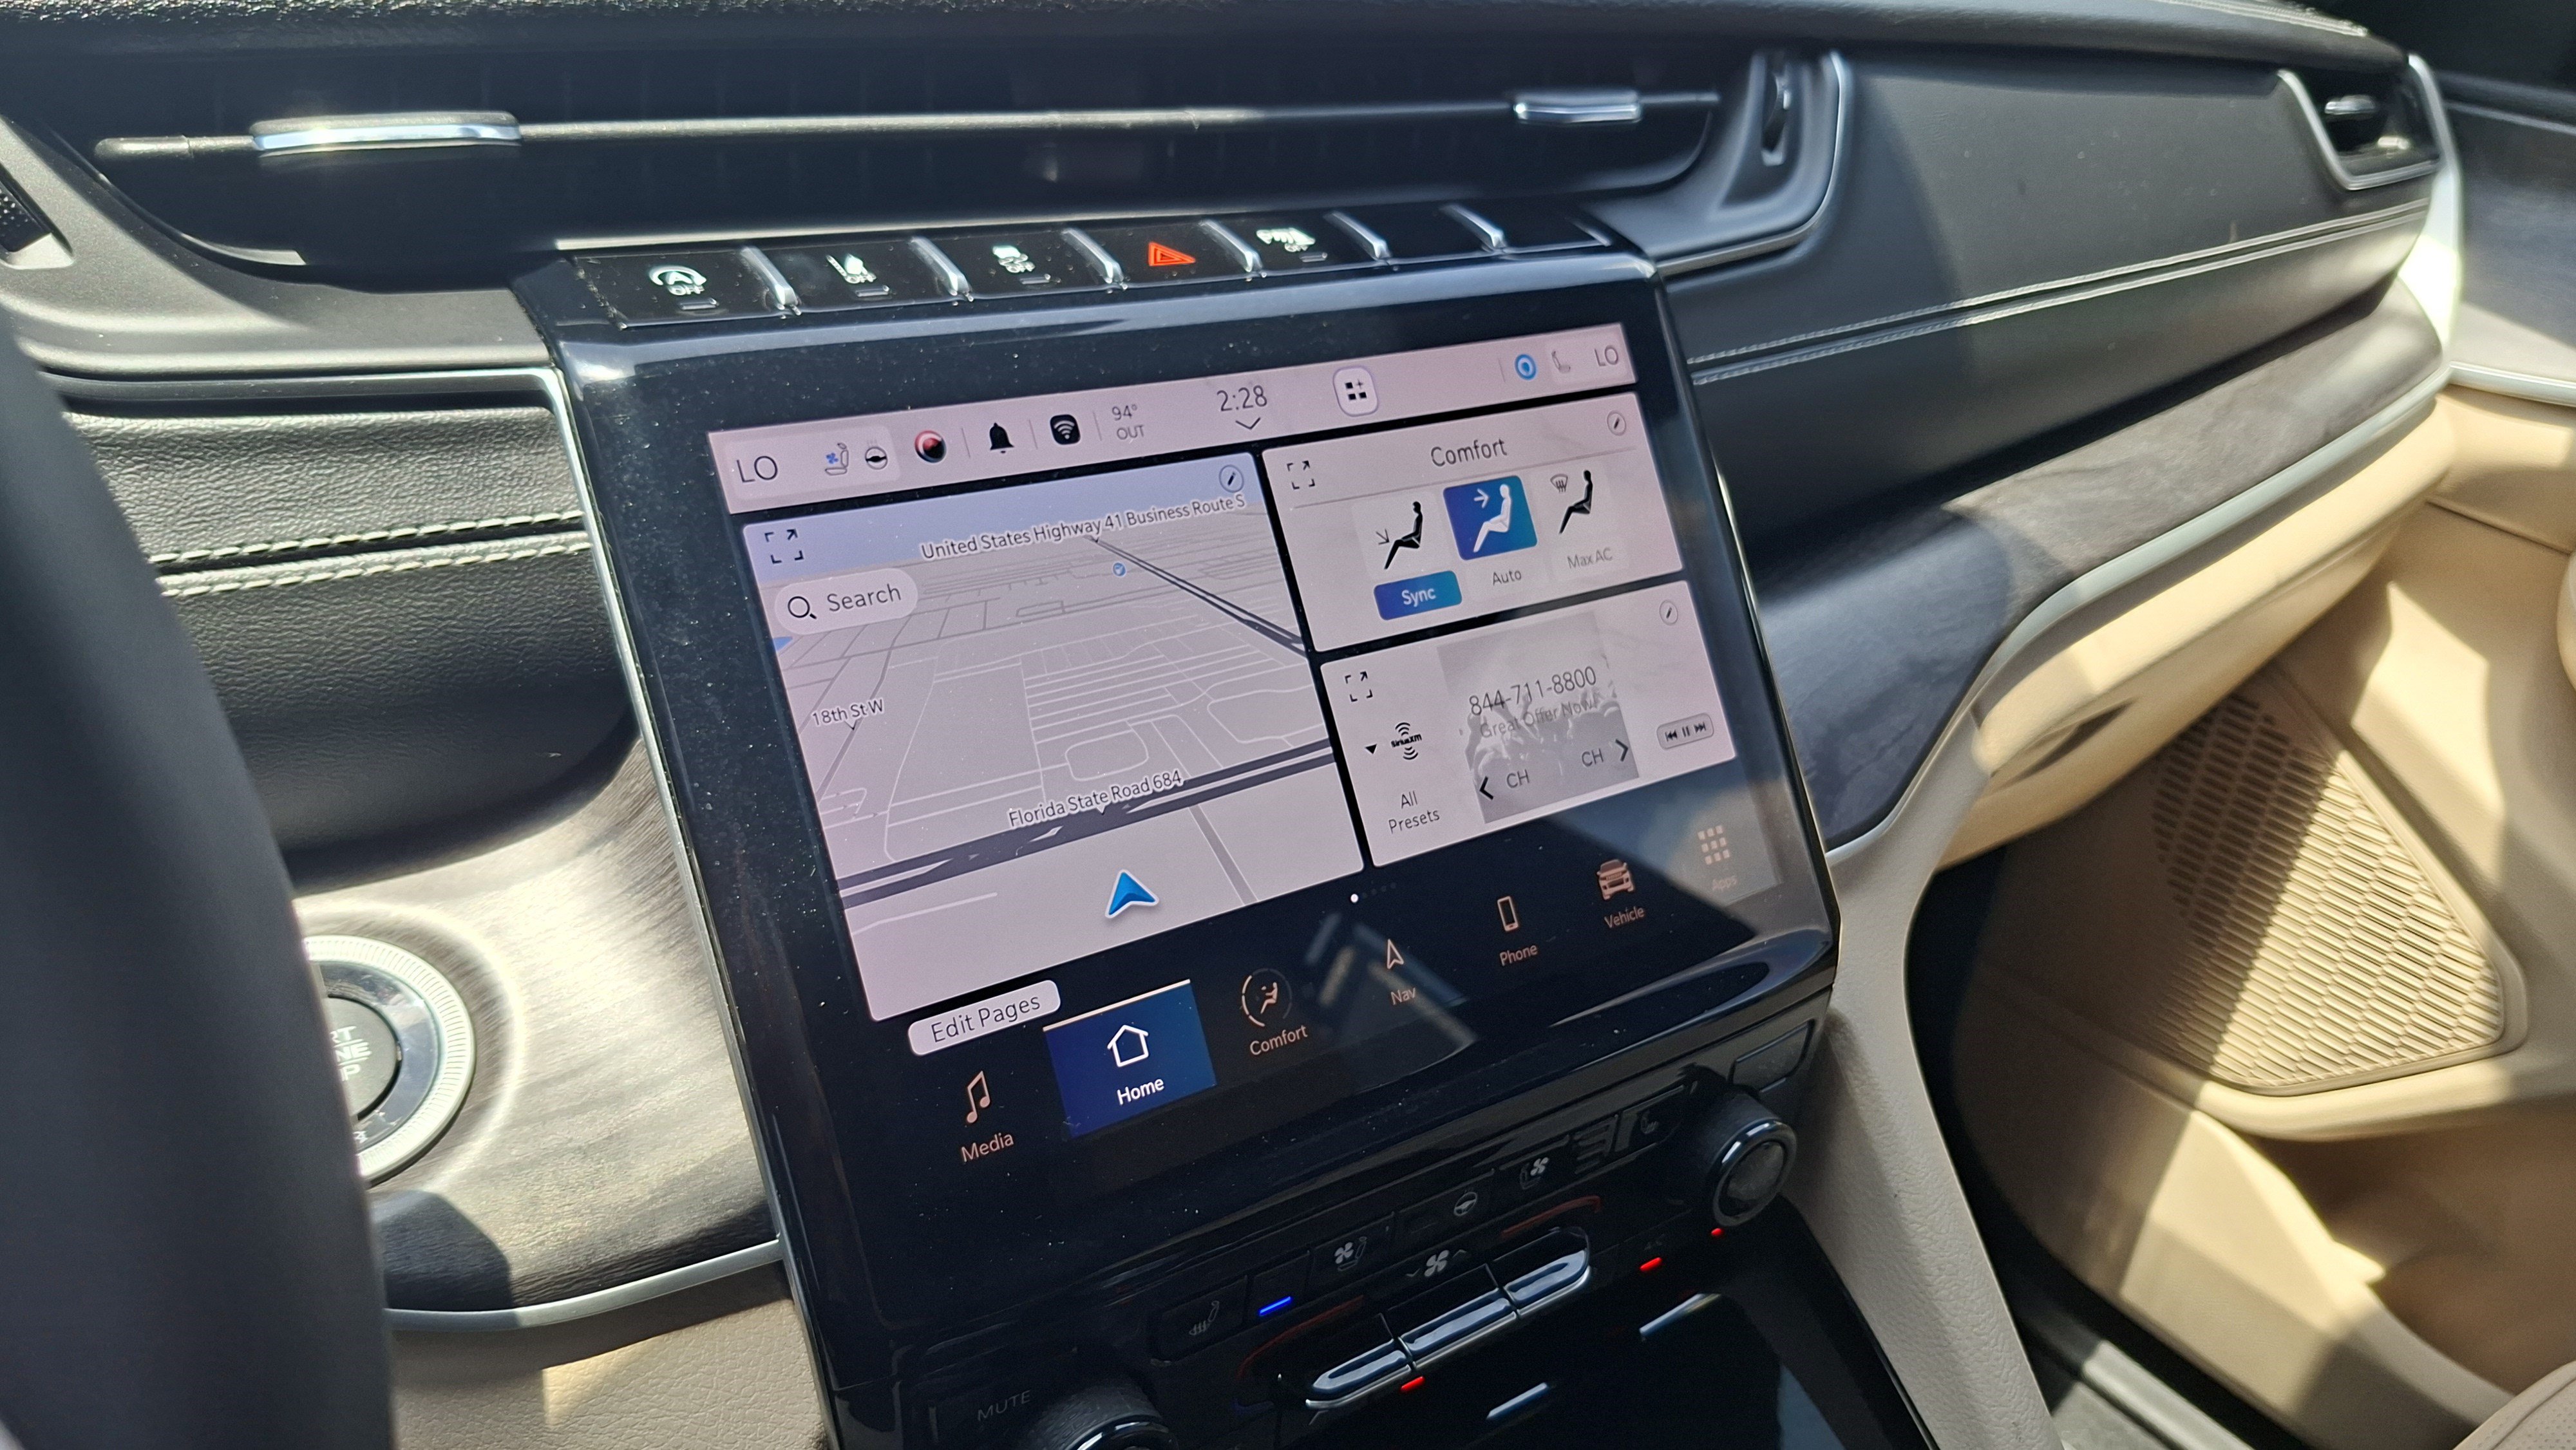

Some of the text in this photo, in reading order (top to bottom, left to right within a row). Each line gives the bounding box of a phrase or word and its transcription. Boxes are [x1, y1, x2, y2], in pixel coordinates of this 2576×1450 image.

[1595, 346, 1618, 367] LO
[1217, 386, 1266, 411] 2:28
[1112, 404, 1136, 420] 94°
[1117, 426, 1143, 440] OUT
[1431, 438, 1507, 467] Comfort
[737, 456, 777, 483] LO
[922, 496, 1244, 558] United States Highway 41 Business Route S
[1567, 549, 1612, 569] Max AC
[1493, 570, 1521, 585] Auto
[828, 585, 900, 612] Search
[1402, 587, 1435, 607] Sync
[1470, 666, 1595, 715] 844-711-8800
[813, 700, 882, 726] 18th St W
[1481, 719, 1520, 738] Great
[1524, 708, 1557, 726] Offer
[1582, 749, 1603, 766] CH
[1506, 771, 1528, 788] CH
[1009, 771, 1181, 826] Florida State Road 684
[1401, 791, 1417, 808] All
[1389, 809, 1439, 833] Presets
[1712, 876, 1738, 893] Apps
[1604, 906, 1645, 928] Vehicle
[1501, 943, 1537, 966] Phone
[1391, 986, 1416, 1005] Nav
[931, 994, 1040, 1042] Edit Pages
[1250, 1026, 1307, 1055] Comfort
[1117, 1078, 1163, 1105] Home
[961, 1131, 1013, 1162] Media
[978, 1390, 1030, 1420] MUTE
